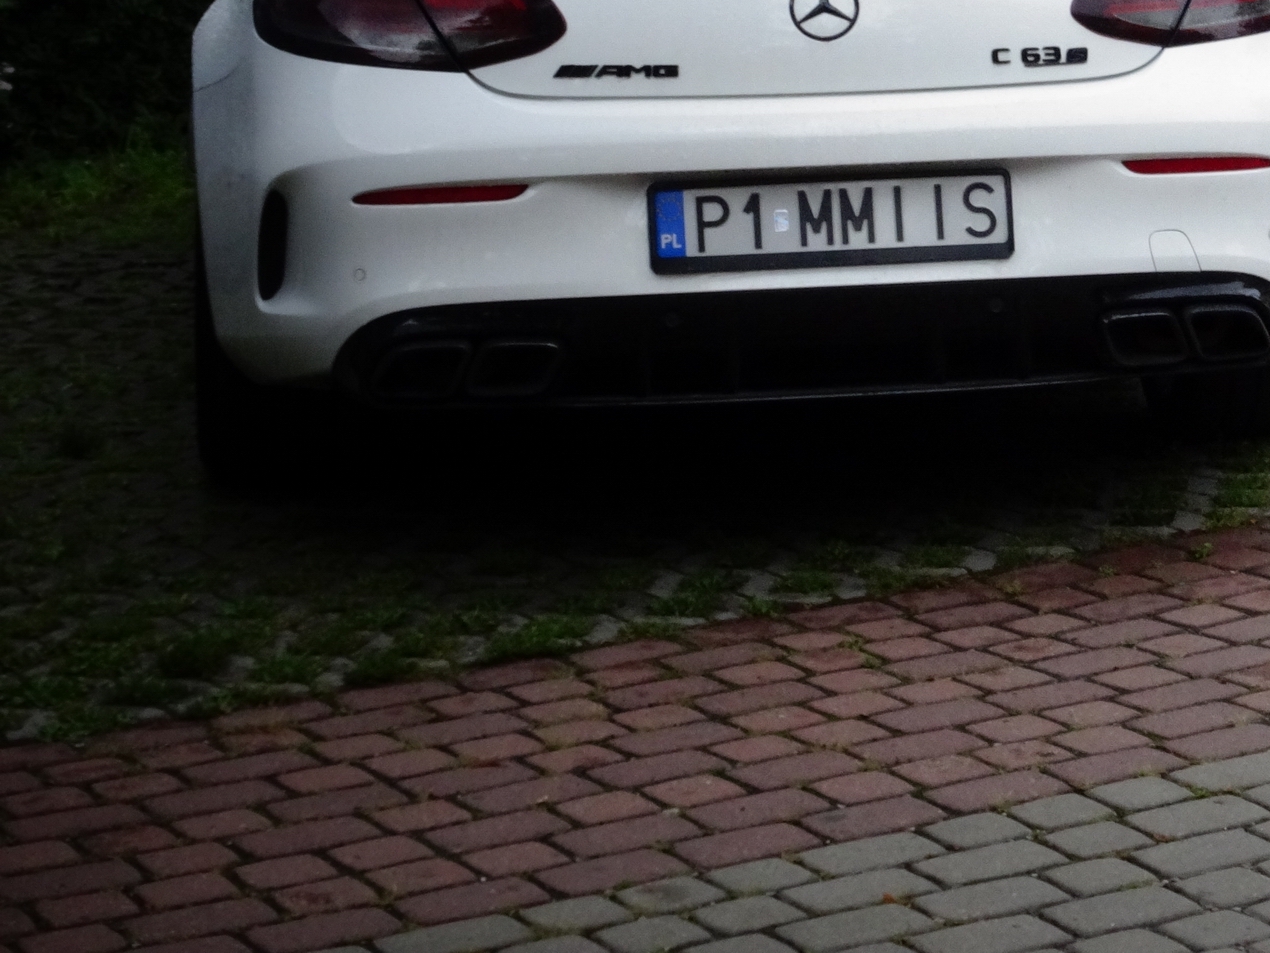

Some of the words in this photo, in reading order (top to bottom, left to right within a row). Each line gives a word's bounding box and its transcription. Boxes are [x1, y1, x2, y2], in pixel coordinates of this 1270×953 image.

[991, 48, 1011, 64] C
[695, 192, 763, 253] P1
[660, 234, 682, 250] PL
